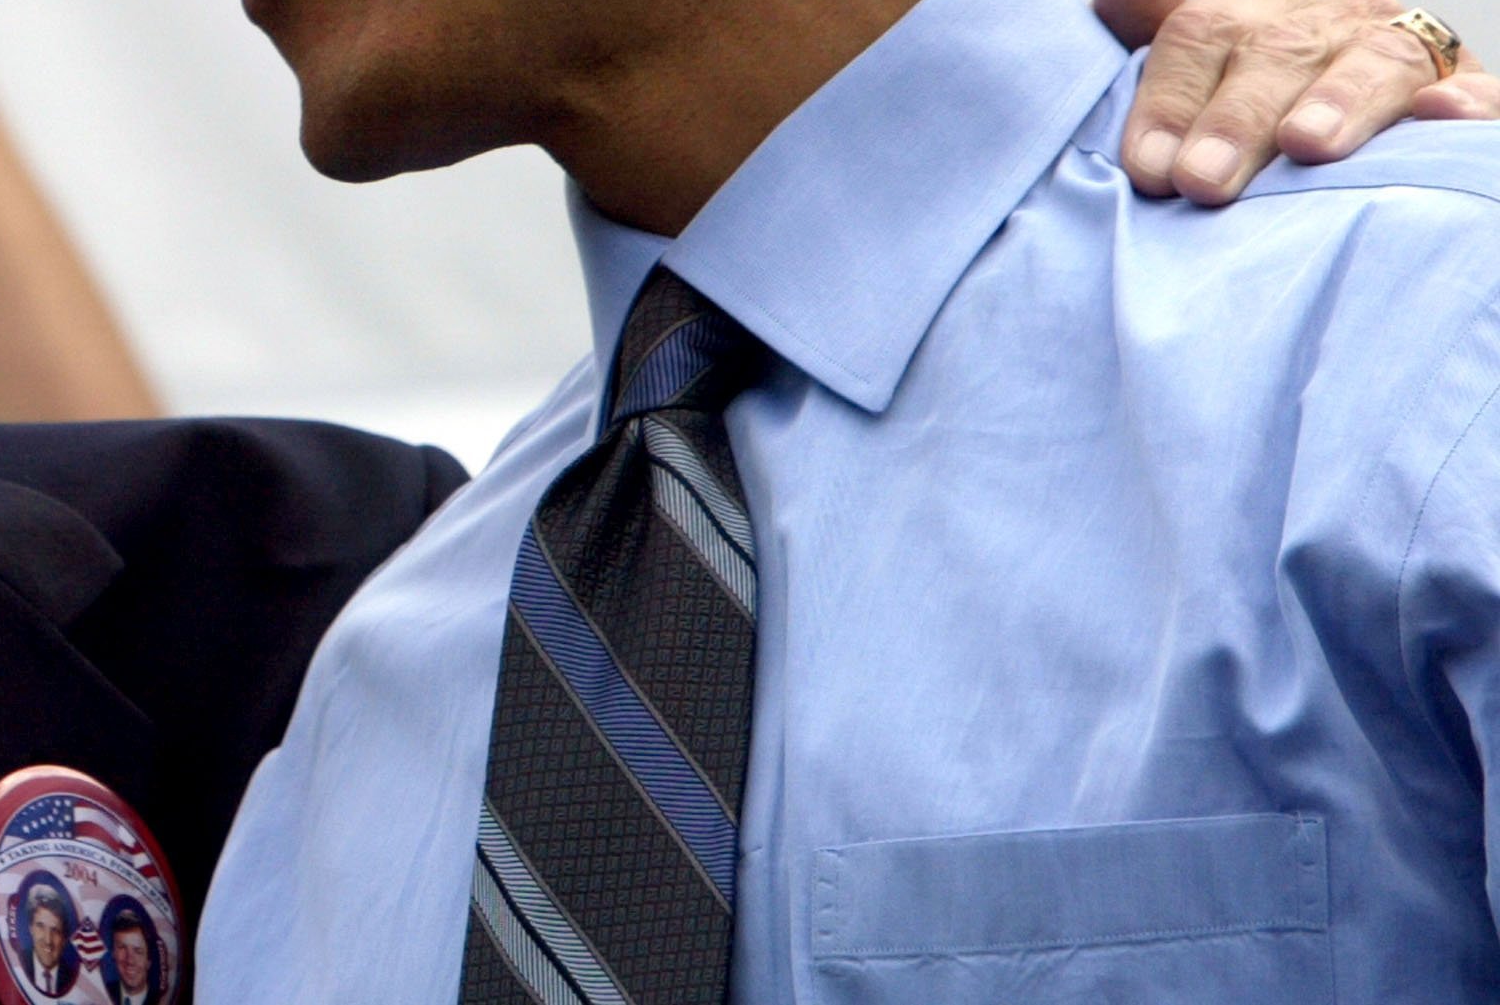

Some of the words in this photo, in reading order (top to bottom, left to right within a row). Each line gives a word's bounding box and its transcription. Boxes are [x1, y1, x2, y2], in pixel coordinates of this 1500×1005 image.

[8, 842, 50, 861] TAKING
[54, 843, 107, 863] AMERICA
[63, 860, 98, 887] 2004
